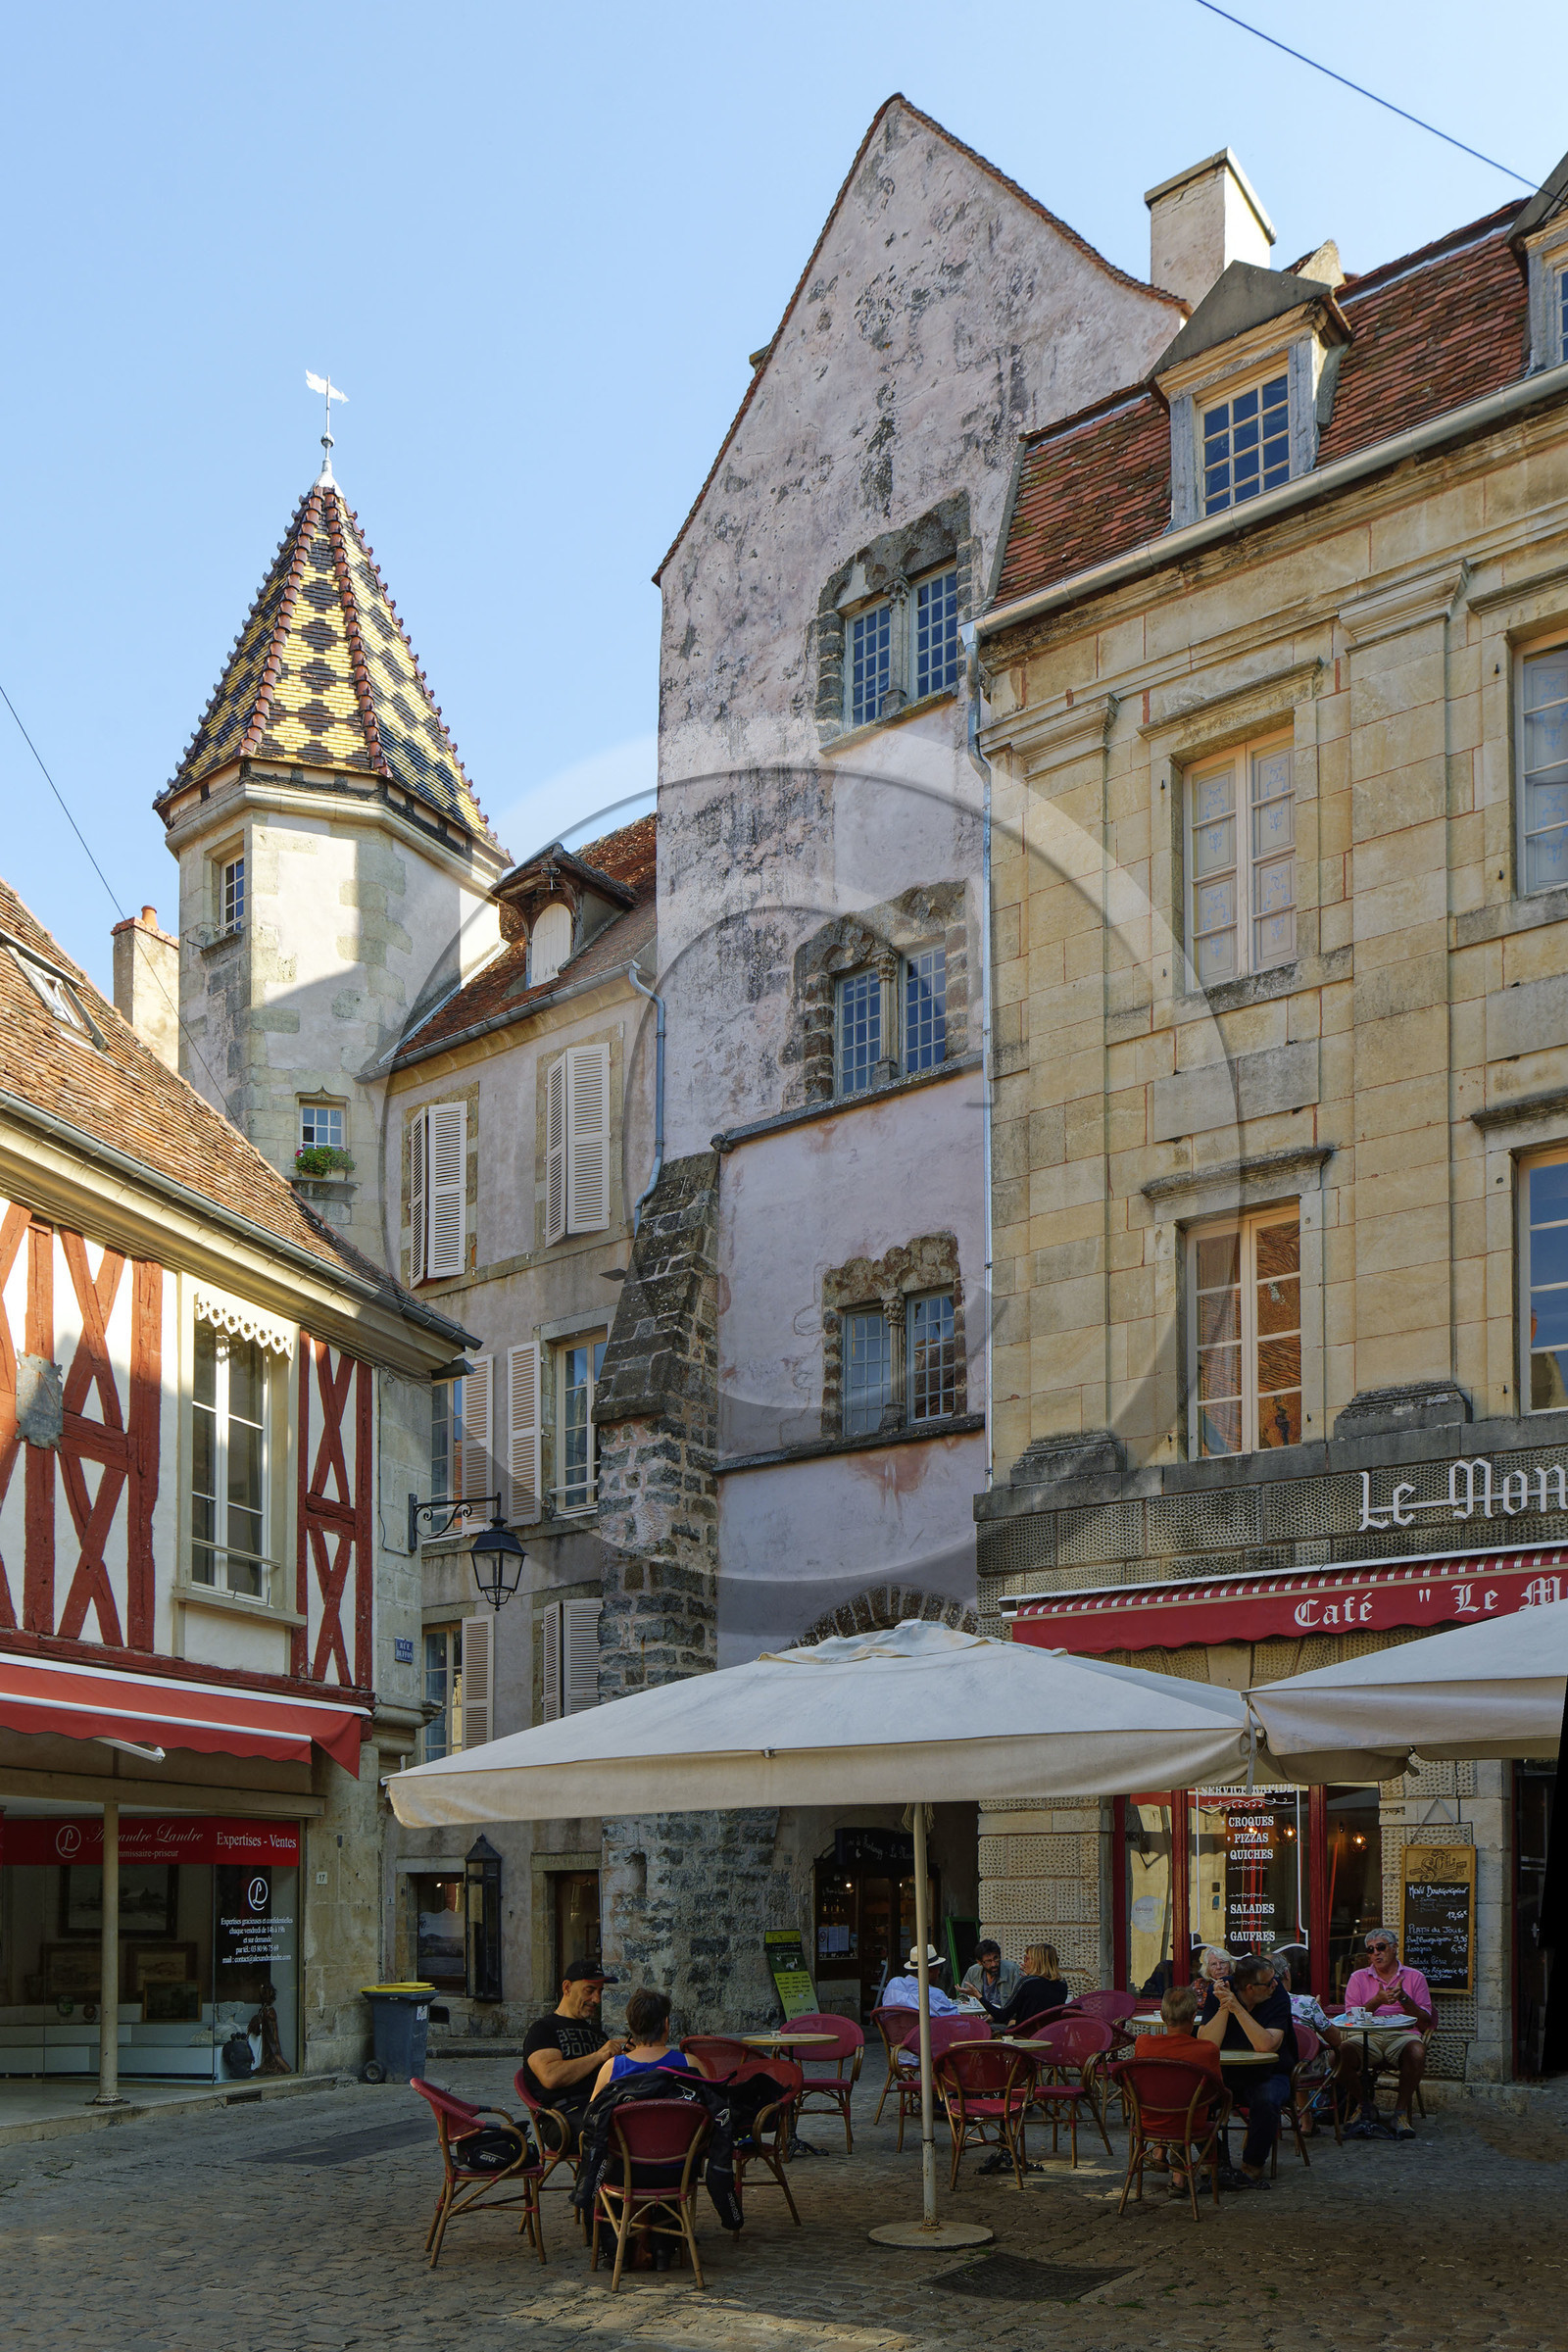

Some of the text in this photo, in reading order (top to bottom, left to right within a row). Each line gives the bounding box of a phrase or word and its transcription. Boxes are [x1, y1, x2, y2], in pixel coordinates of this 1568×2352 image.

[1357, 1470, 1416, 1532] Le
[1294, 1592, 1373, 1628] Café
[1450, 1583, 1498, 1615] Le
[1228, 1815, 1275, 1828] CROQUES
[156, 1823, 204, 1843] Landre
[1234, 1833, 1269, 1843] PIZZAS
[217, 1832, 262, 1849] Expertises
[270, 1834, 297, 1848] Ventes
[1229, 1848, 1274, 1860] QUICHES
[1229, 1903, 1275, 1914] SALADES
[220, 1917, 241, 1927] Expertises
[1229, 1931, 1276, 1941] GAUFRES
